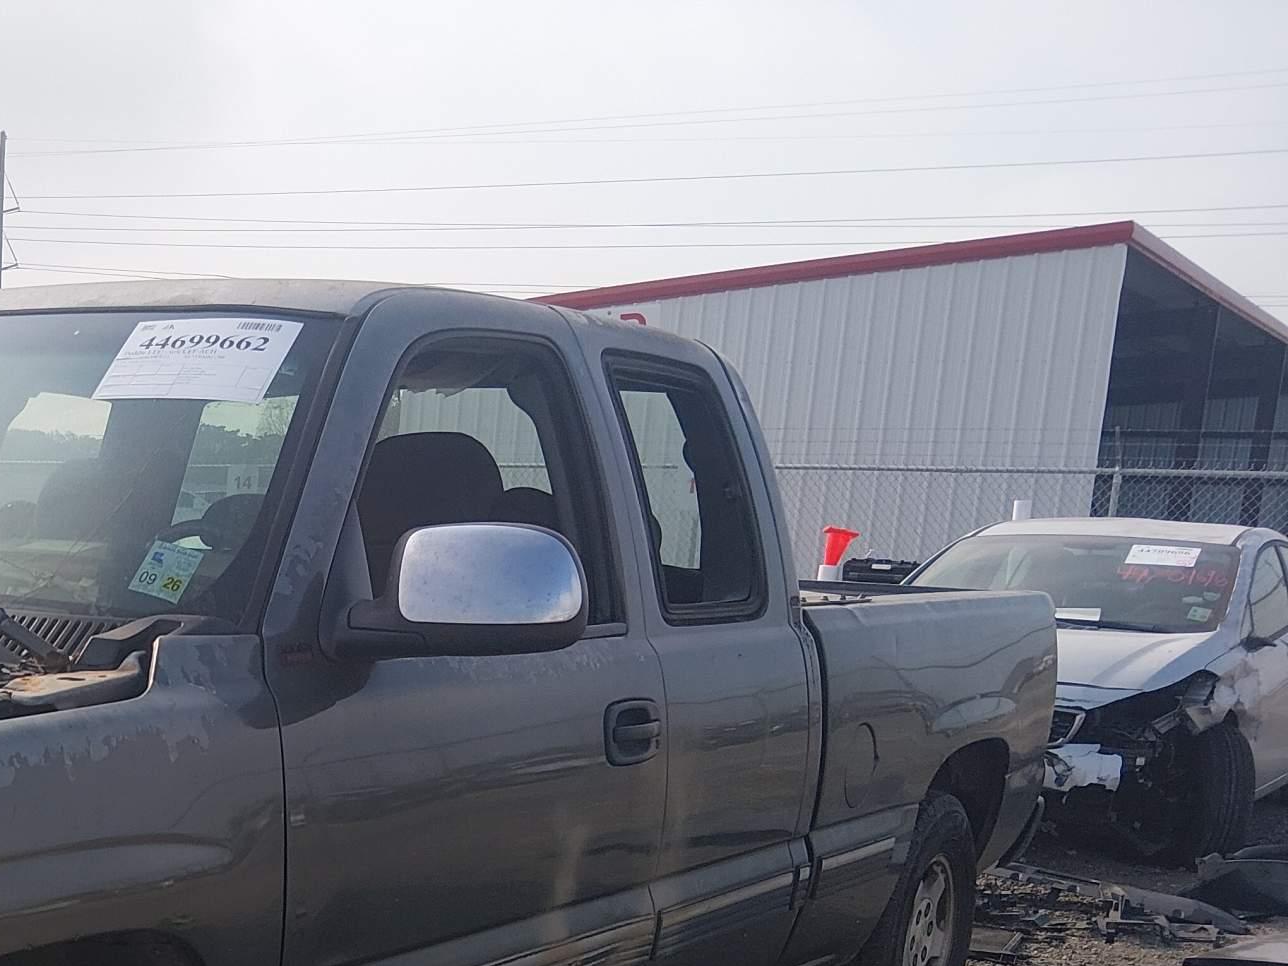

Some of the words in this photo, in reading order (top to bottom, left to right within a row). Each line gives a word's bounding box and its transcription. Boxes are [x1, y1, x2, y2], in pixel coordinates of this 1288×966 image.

[138, 333, 270, 352] 44699662
[139, 571, 158, 585] 09
[162, 577, 183, 592] 26
